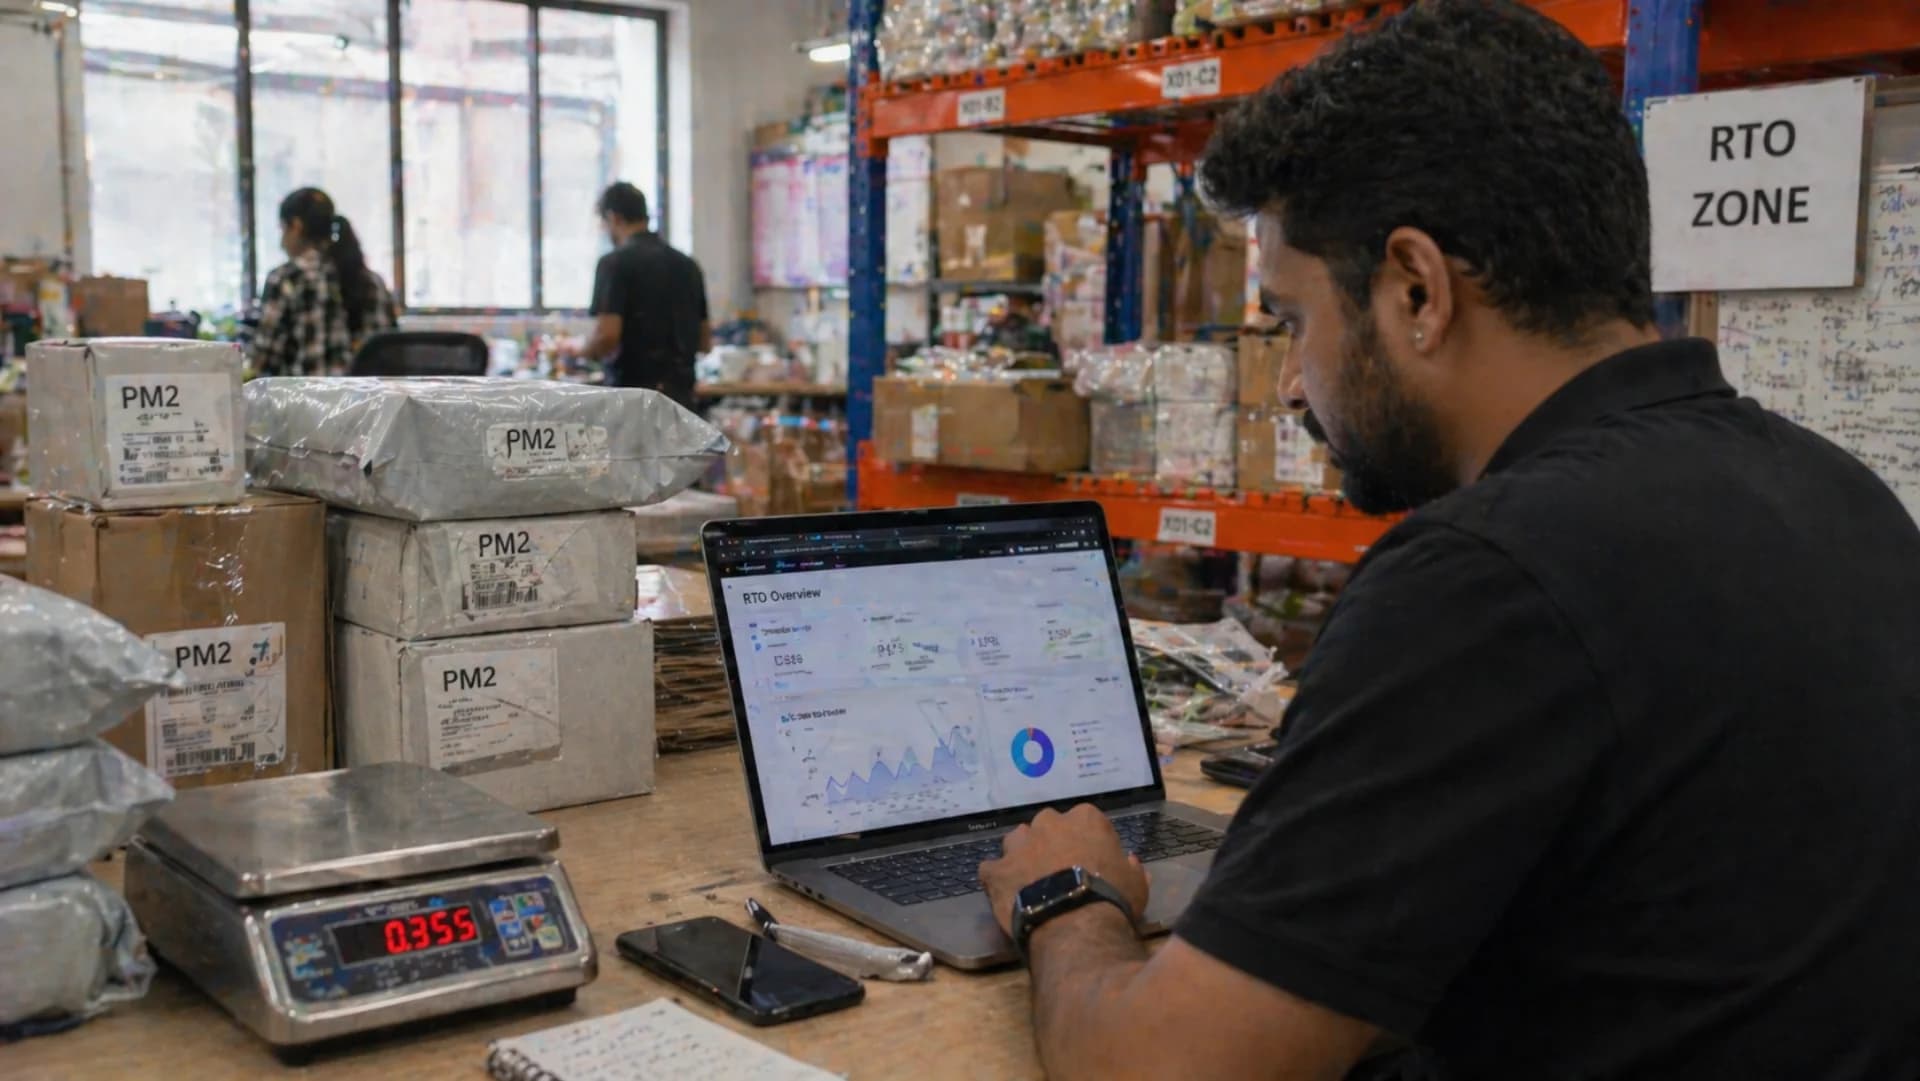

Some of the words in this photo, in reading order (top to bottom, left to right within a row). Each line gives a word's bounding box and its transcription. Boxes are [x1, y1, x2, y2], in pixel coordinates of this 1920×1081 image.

[1709, 119, 1796, 162] RTO
[1691, 186, 1810, 228] ZONE
[121, 385, 181, 409] PM2
[506, 428, 557, 457] PM2
[478, 530, 531, 558] PM2
[742, 591, 767, 606] RTO
[770, 588, 822, 602] Overview
[175, 641, 233, 669] PM2
[442, 666, 498, 693] PM2
[385, 907, 477, 954] 0.355
